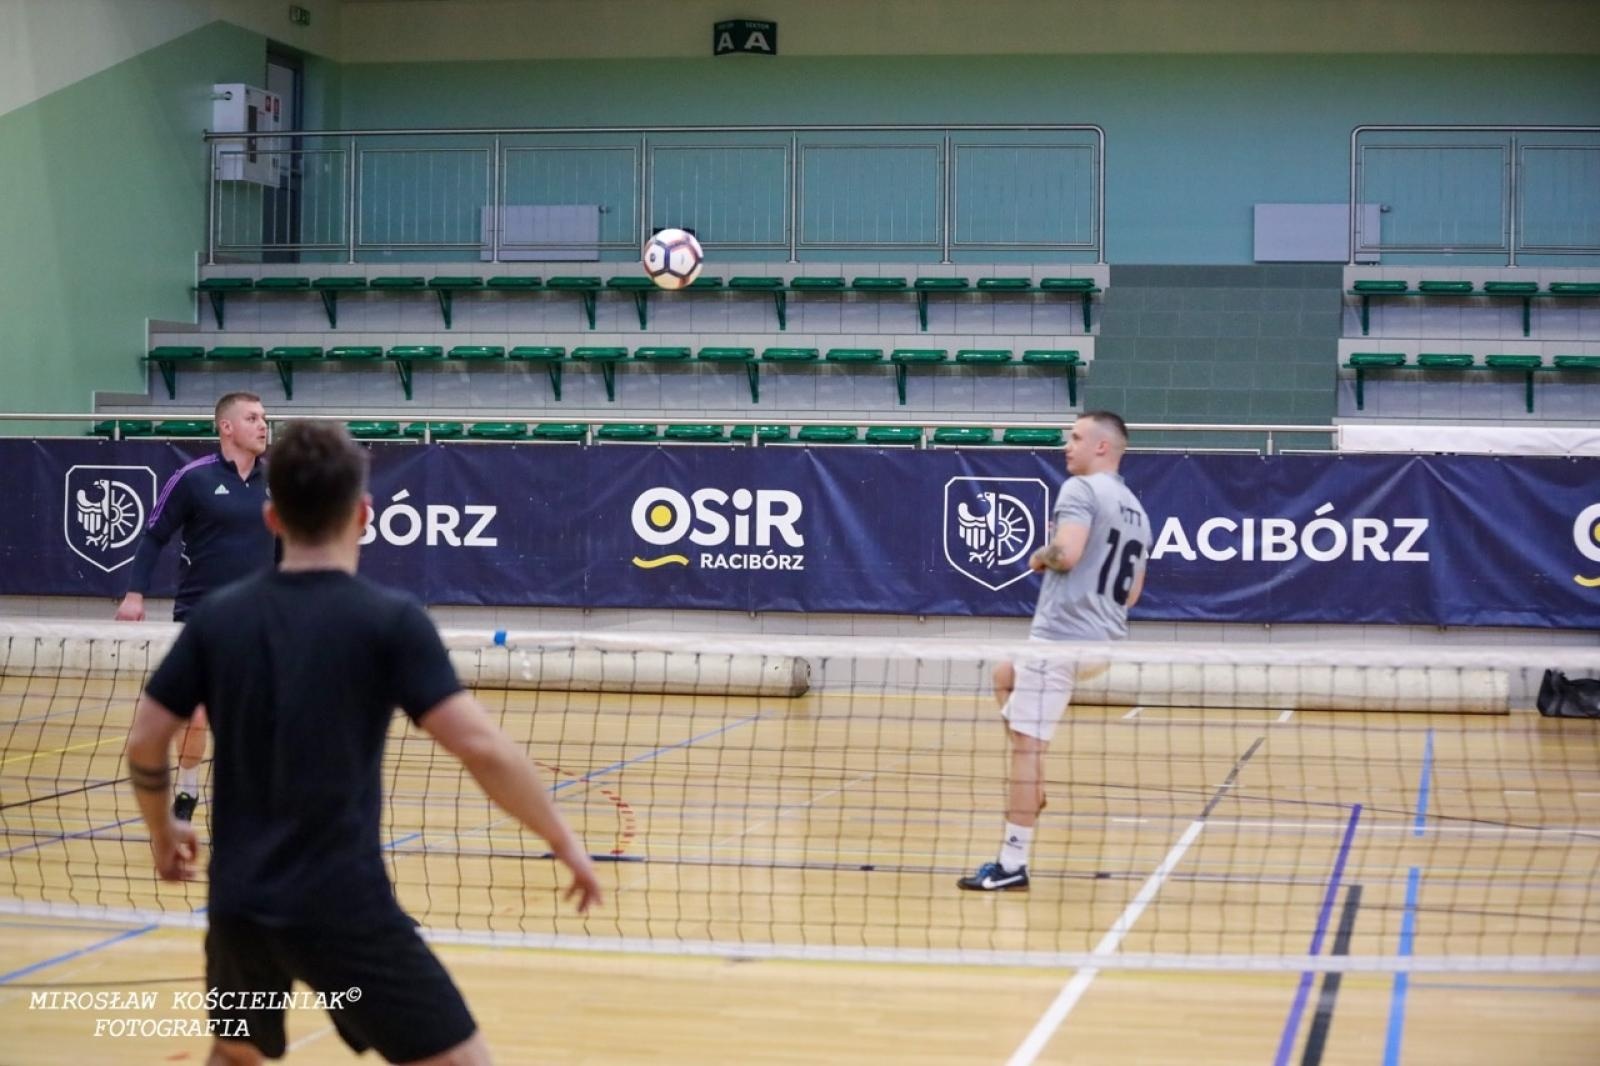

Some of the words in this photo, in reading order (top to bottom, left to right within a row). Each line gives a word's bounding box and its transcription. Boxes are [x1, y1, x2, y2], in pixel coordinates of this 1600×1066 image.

[717, 32, 735, 51] A
[744, 31, 771, 51] A
[1145, 502, 1430, 562] ACIBÓRZ
[700, 549, 804, 570] RACIBÓRZ
[1096, 527, 1143, 606] 16
